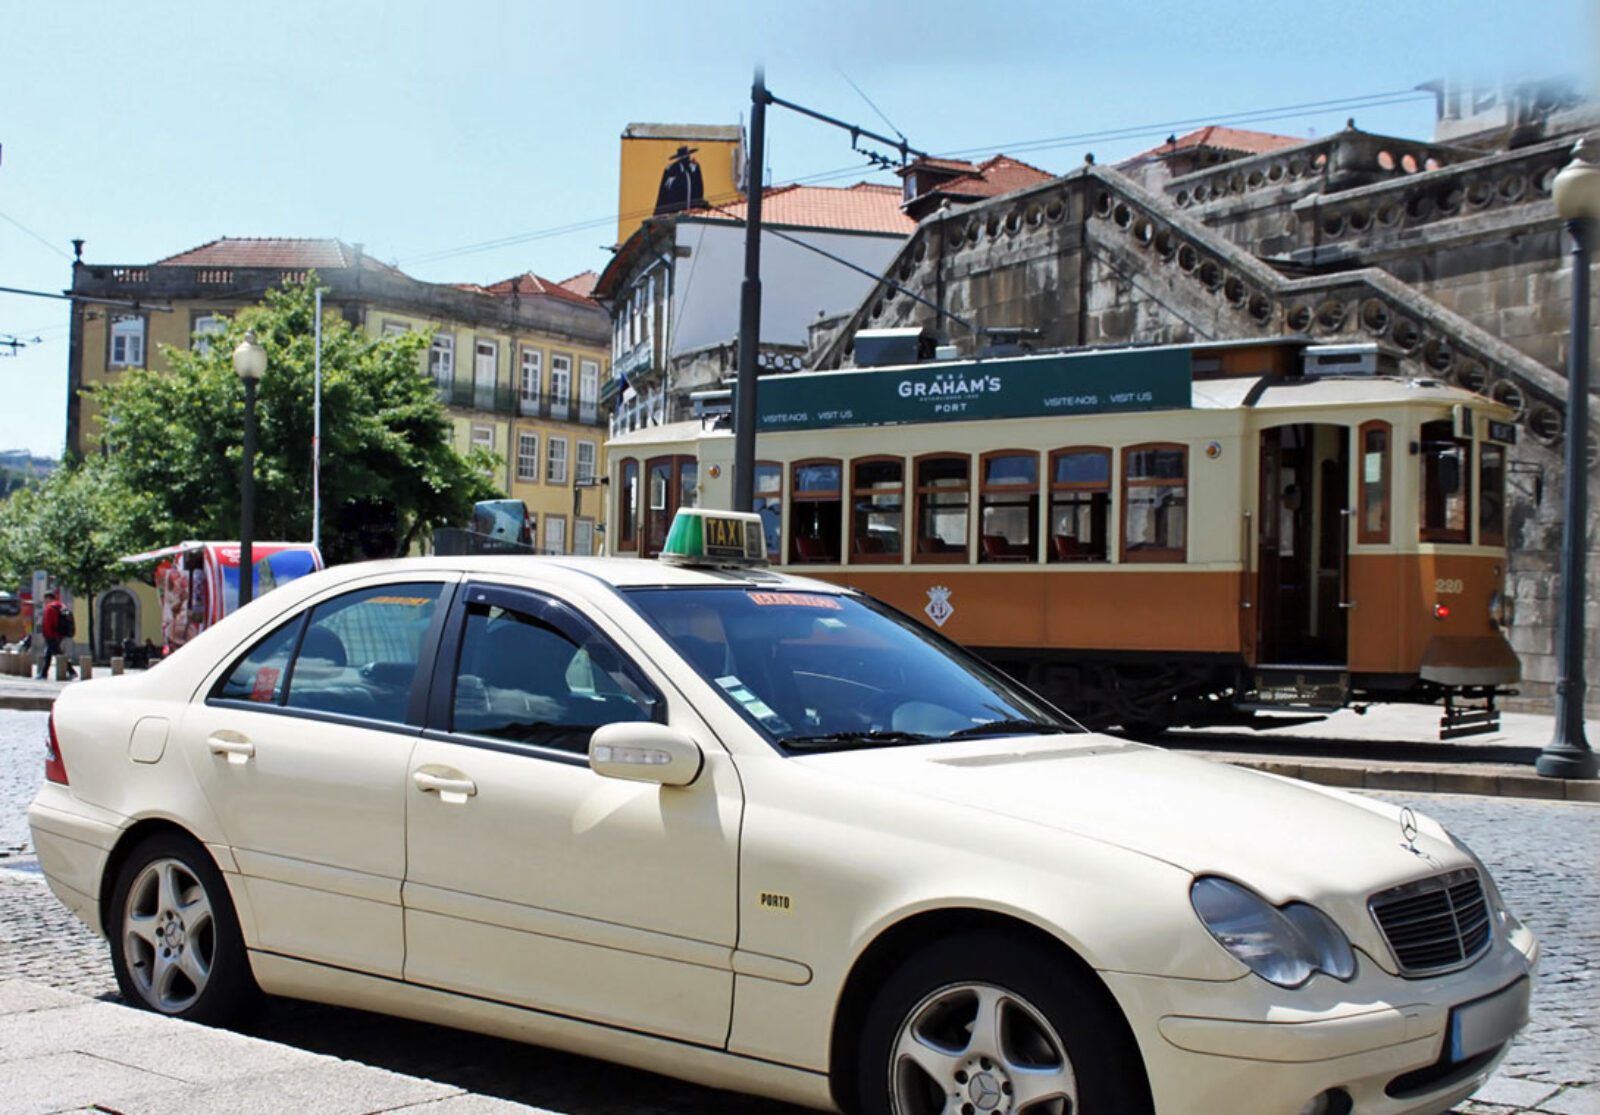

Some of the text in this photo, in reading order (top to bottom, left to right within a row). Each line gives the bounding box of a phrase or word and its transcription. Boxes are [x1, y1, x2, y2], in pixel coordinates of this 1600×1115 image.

[898, 375, 1001, 397] GRAHAM'S
[935, 403, 968, 413] PORT
[707, 519, 743, 545] TAXI
[1435, 578, 1463, 594] 220
[760, 892, 790, 909] PORTO
